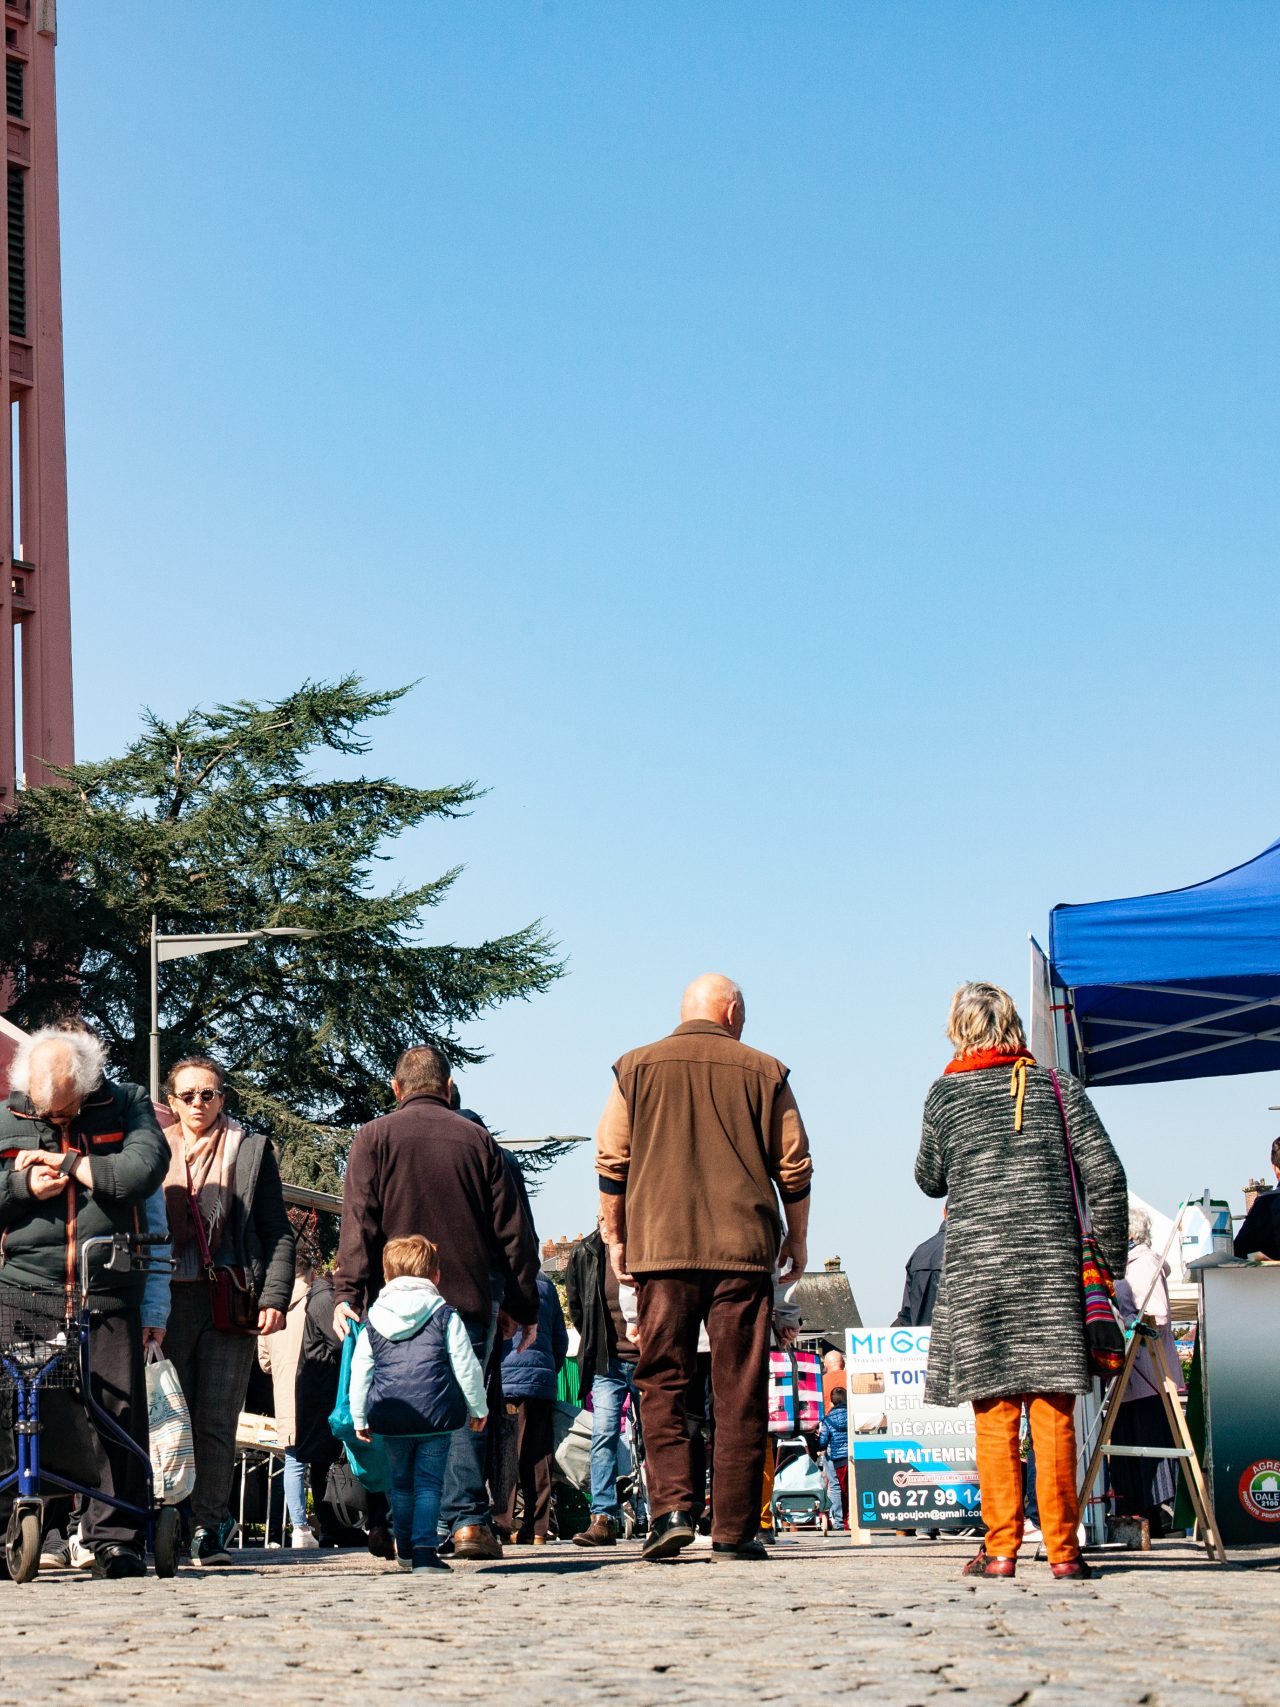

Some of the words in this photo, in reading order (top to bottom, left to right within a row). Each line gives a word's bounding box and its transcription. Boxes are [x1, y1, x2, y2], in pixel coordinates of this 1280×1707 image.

[878, 1490, 901, 1507] 06
[906, 1490, 928, 1506] 27
[934, 1489, 957, 1505] 99
[881, 1509, 982, 1521] wg.goujon@gmail.co
